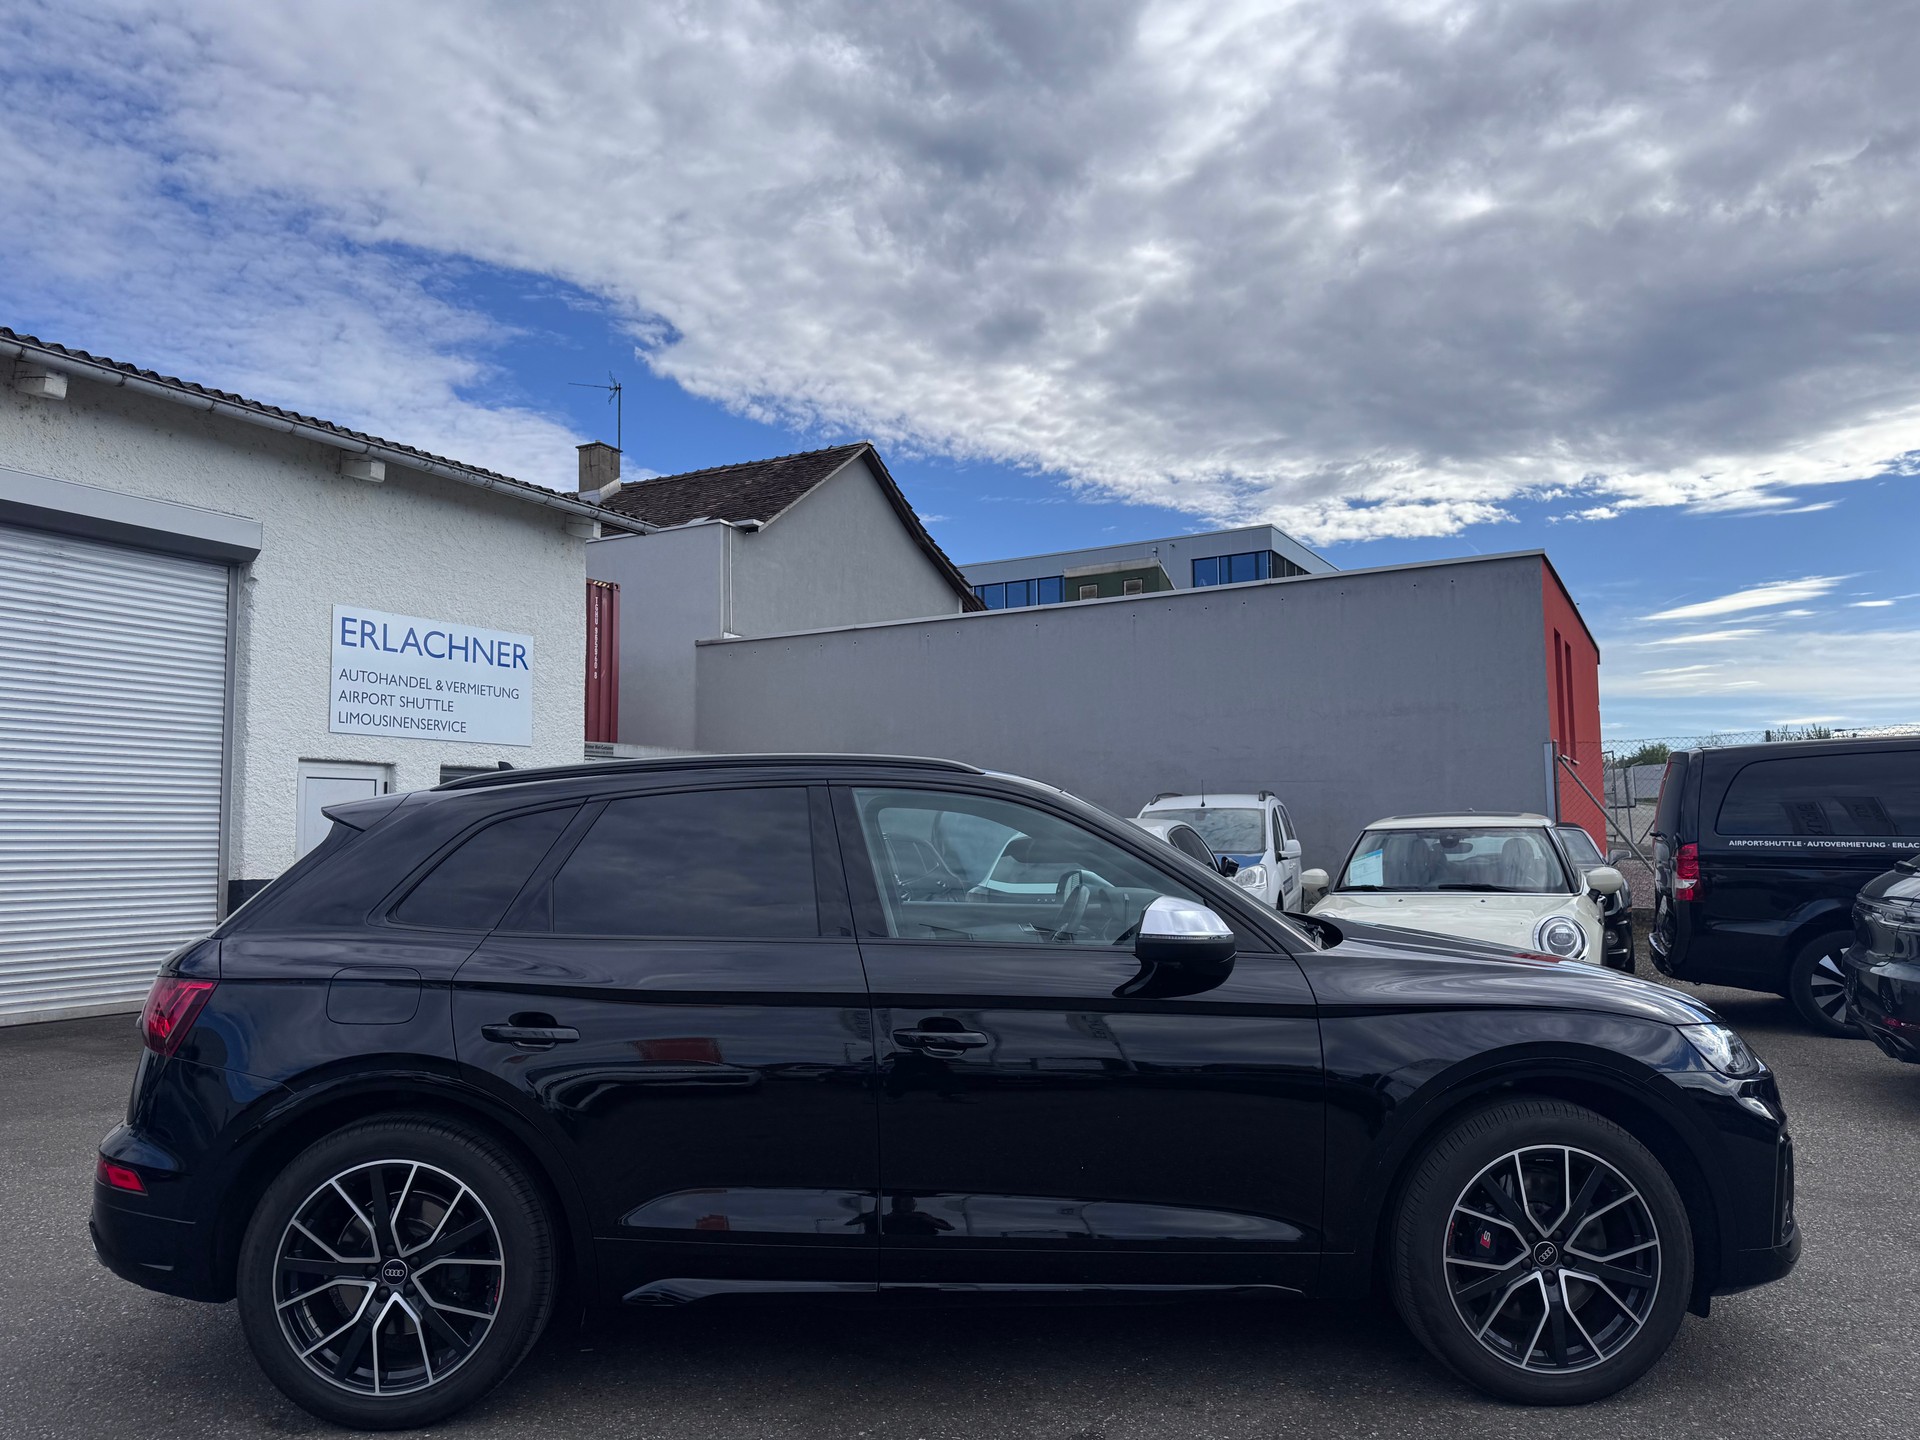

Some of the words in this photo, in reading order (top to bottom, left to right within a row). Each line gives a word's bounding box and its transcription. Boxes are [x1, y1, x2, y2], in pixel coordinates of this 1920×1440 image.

[341, 616, 529, 671] ERLACHNER
[339, 668, 432, 690] AUTOHANDEL
[435, 679, 444, 691] &
[445, 680, 520, 700] VERMIETUNG
[338, 689, 396, 707] AIRPORT
[399, 695, 454, 712] SHUTTLE
[338, 711, 467, 733] LIMOUSINENSERVICE
